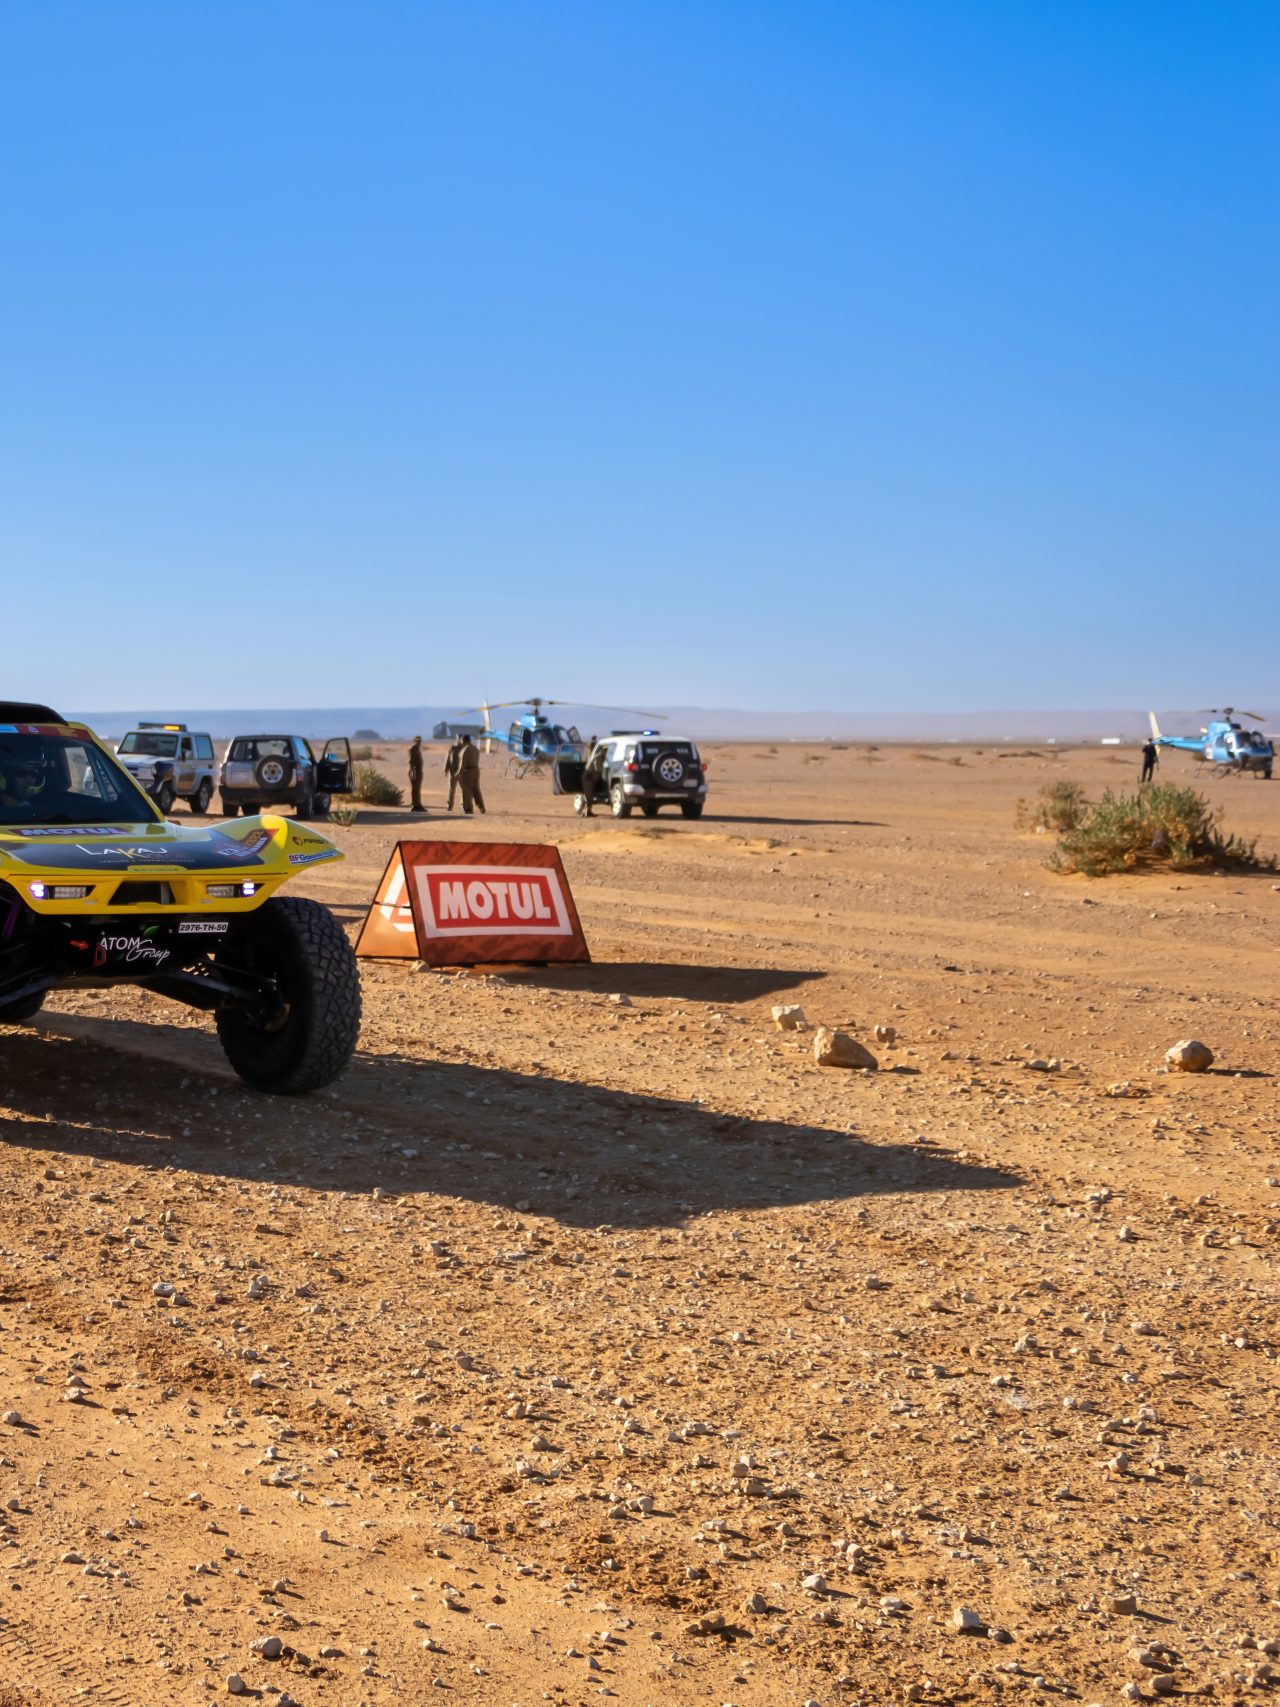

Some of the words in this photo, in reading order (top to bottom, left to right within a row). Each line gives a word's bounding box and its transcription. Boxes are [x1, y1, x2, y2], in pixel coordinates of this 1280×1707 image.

[20, 828, 124, 836] MOTUL
[439, 881, 551, 920] MOTUL
[180, 924, 227, 932] 2976-TH-50
[100, 937, 140, 950] ATOM
[126, 940, 170, 966] Group
